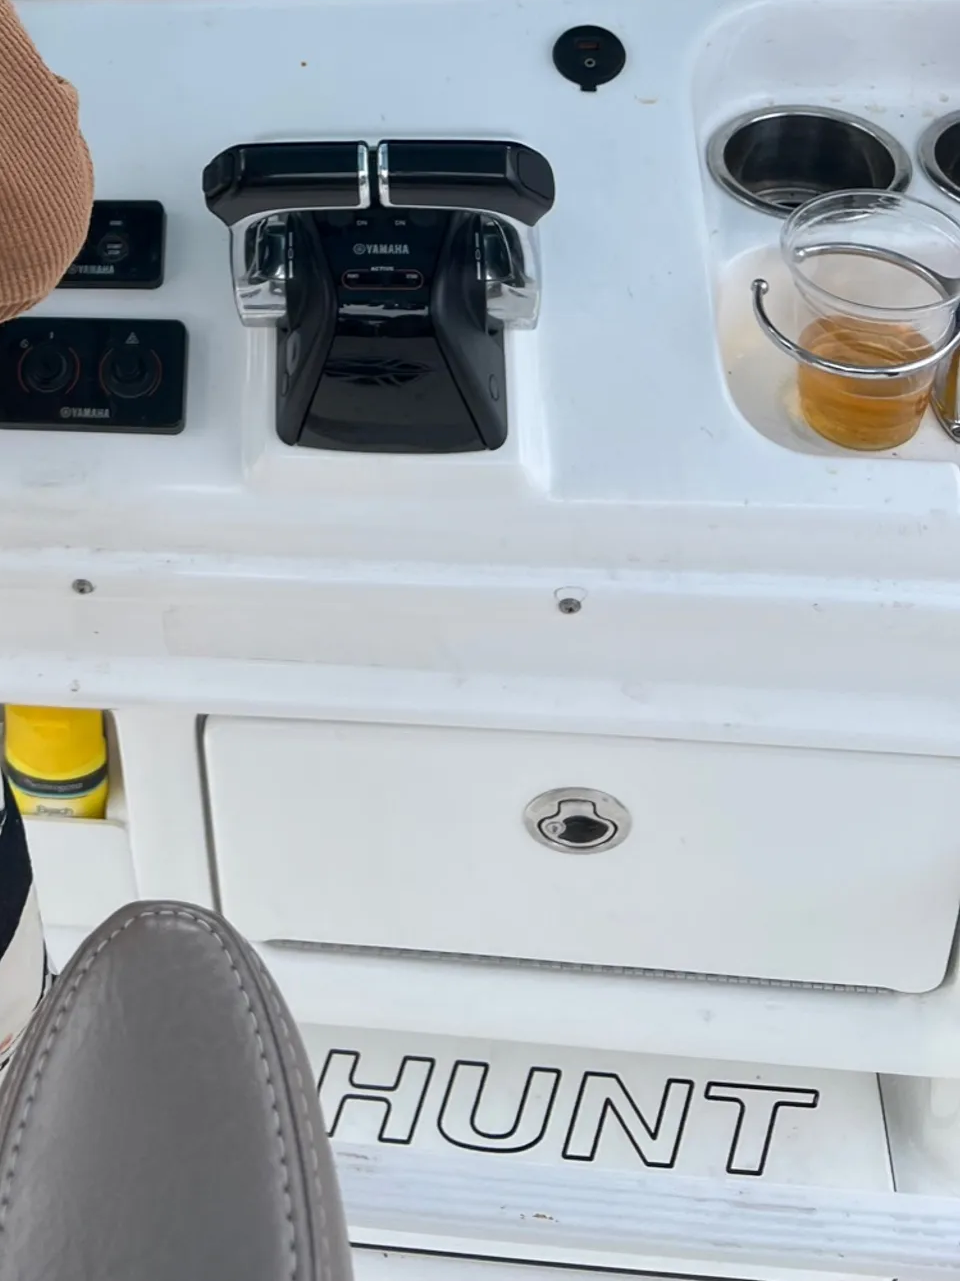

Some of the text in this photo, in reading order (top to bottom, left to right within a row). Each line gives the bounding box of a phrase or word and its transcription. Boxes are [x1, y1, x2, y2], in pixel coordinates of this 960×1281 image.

[366, 244, 410, 255] YAMAHA
[78, 264, 115, 275] YAMAHA
[72, 407, 110, 419] YAMAHA
[318, 1047, 820, 1176] HUNT
